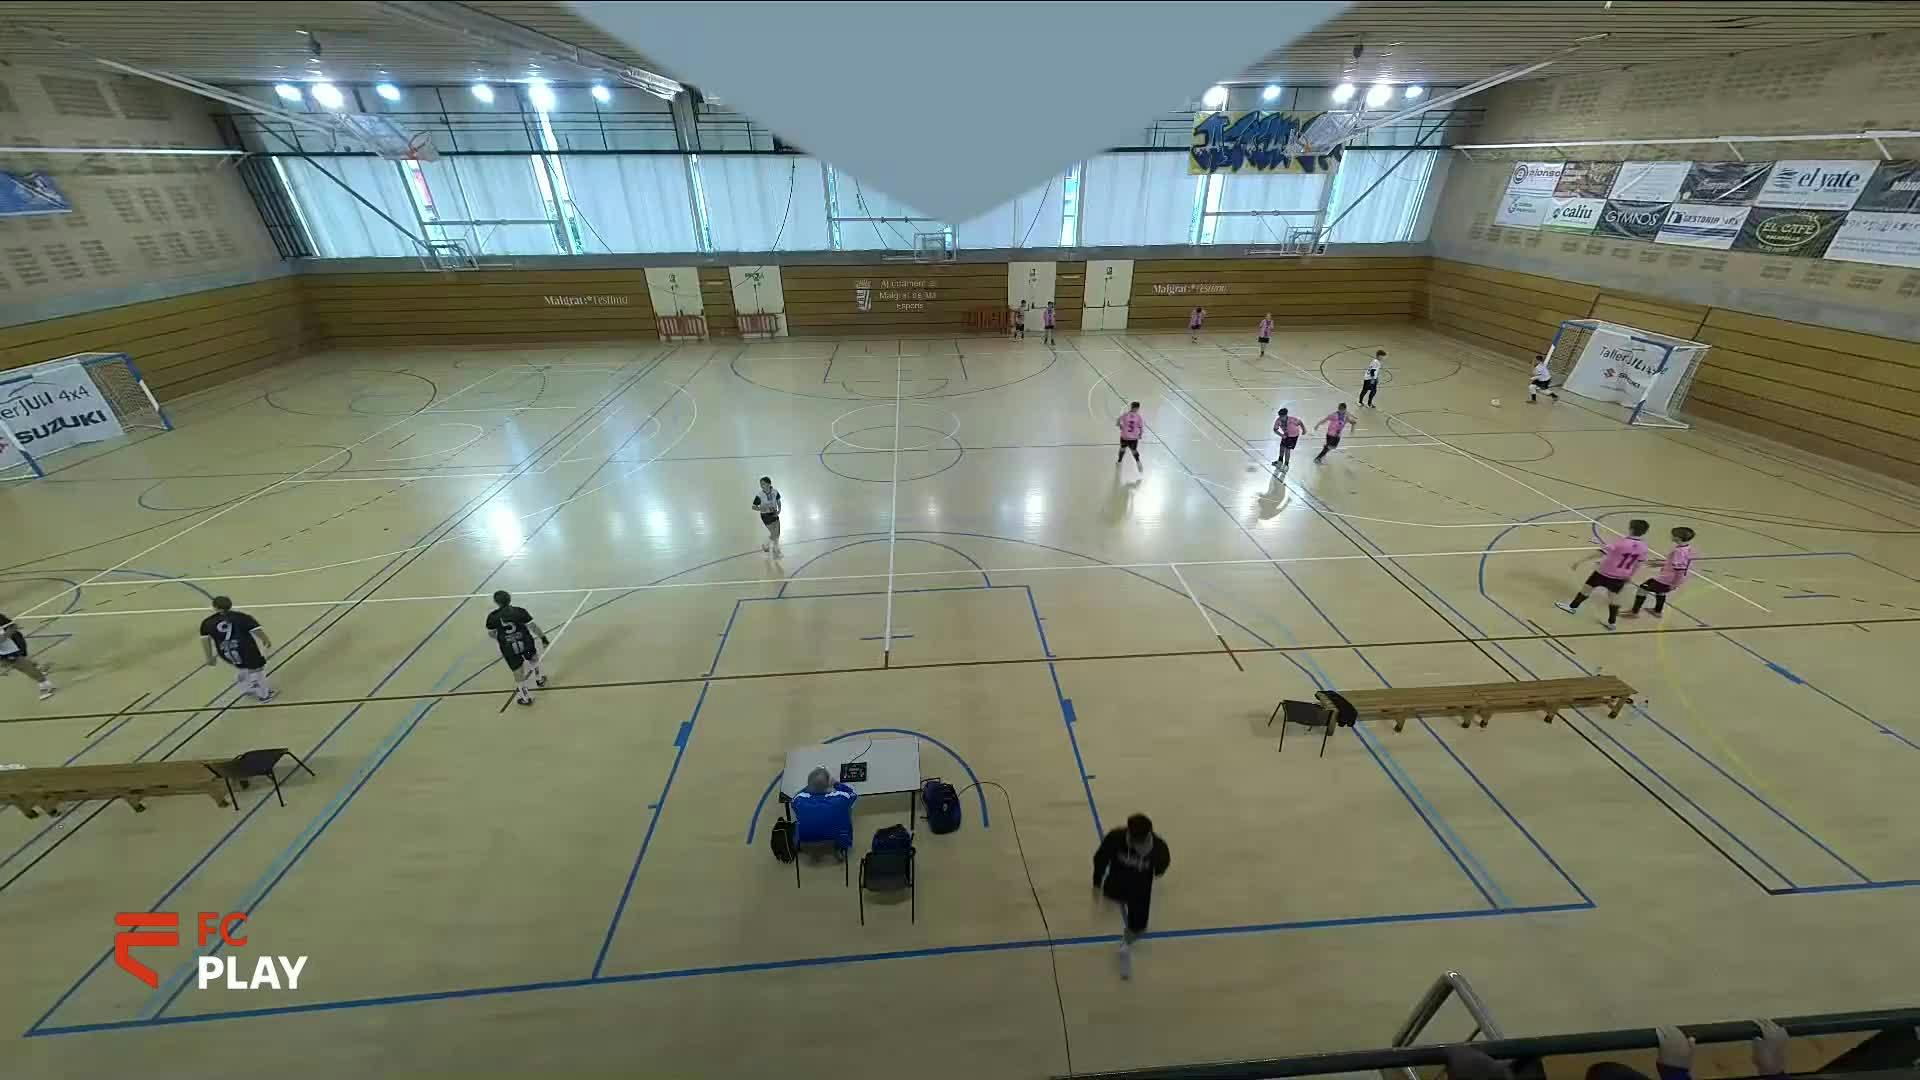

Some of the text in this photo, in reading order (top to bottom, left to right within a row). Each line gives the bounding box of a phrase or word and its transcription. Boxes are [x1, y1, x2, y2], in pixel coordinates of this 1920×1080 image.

[1798, 167, 1860, 192] el yate
[1562, 204, 1593, 219] caliu
[58, 384, 91, 402] 4x4
[15, 409, 107, 444] SUZUKI
[1617, 552, 1640, 570] 11
[216, 620, 233, 641] 9
[500, 617, 517, 635] 5
